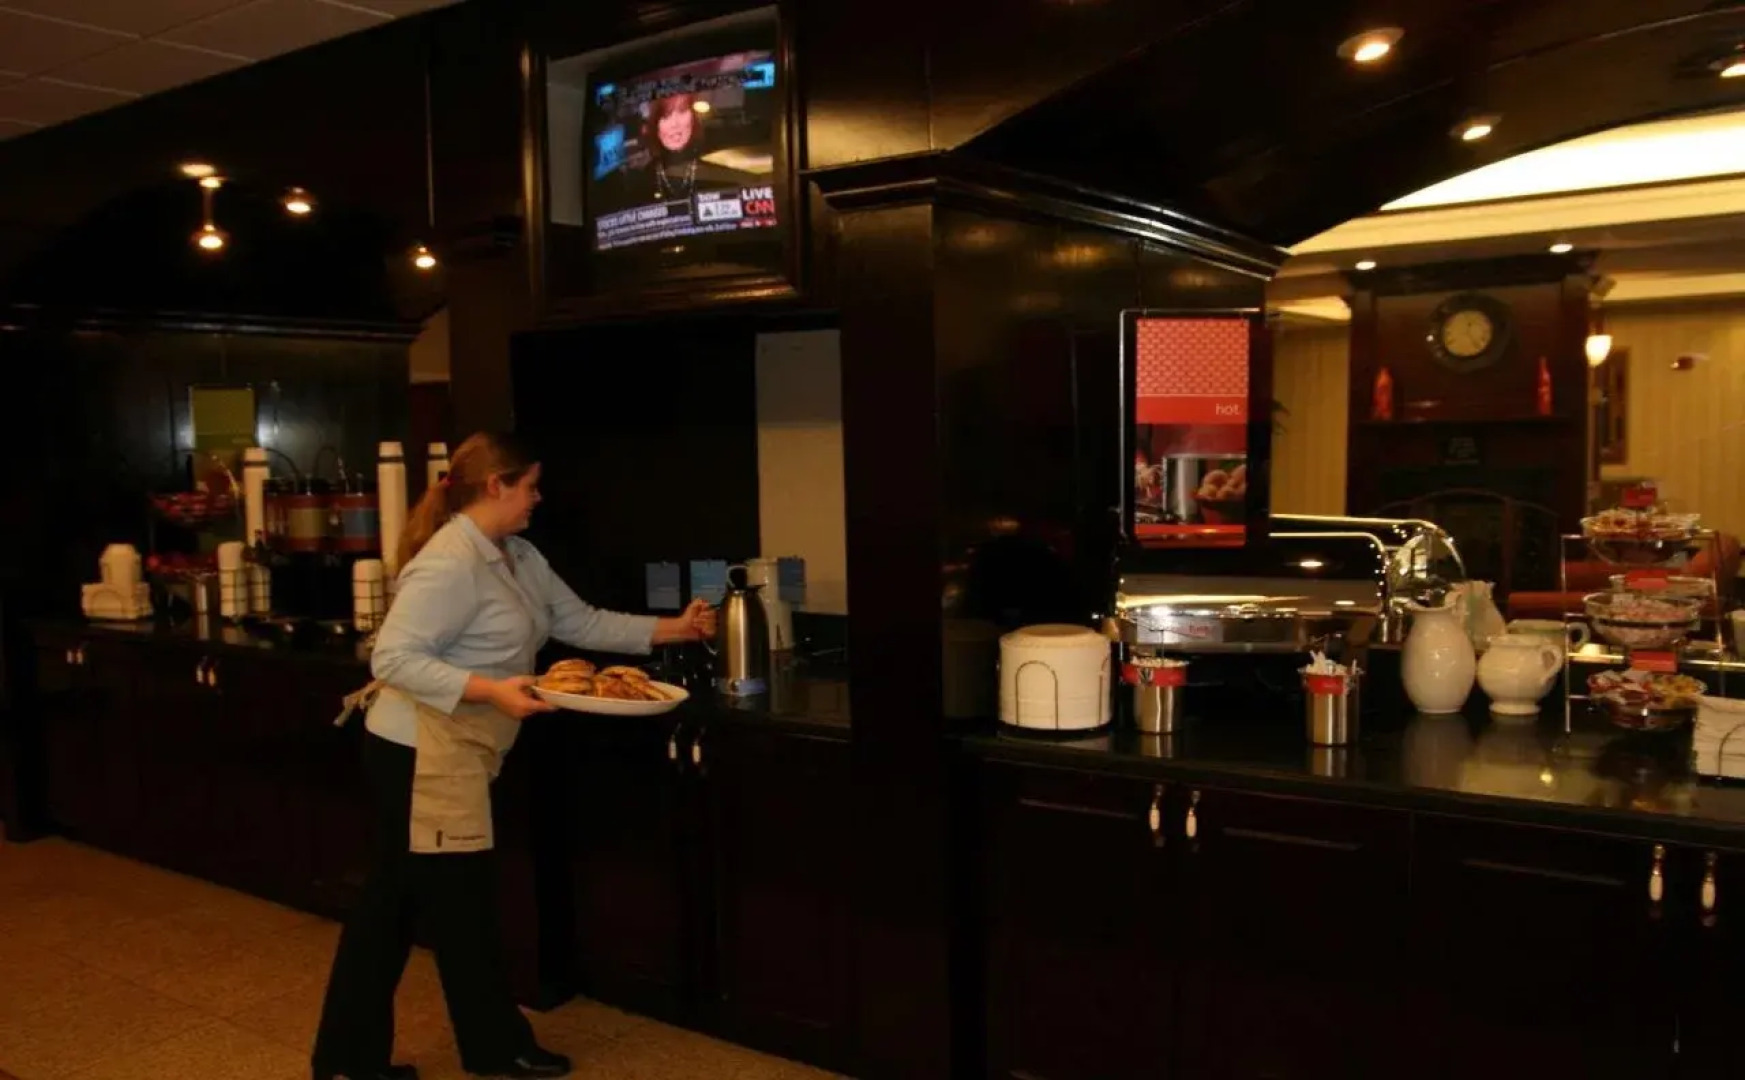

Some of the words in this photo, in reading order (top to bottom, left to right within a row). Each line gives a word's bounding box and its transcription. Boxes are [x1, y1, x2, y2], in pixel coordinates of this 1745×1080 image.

[742, 187, 773, 201] LIVE
[746, 200, 775, 215] CNN
[1215, 403, 1240, 416] hot
